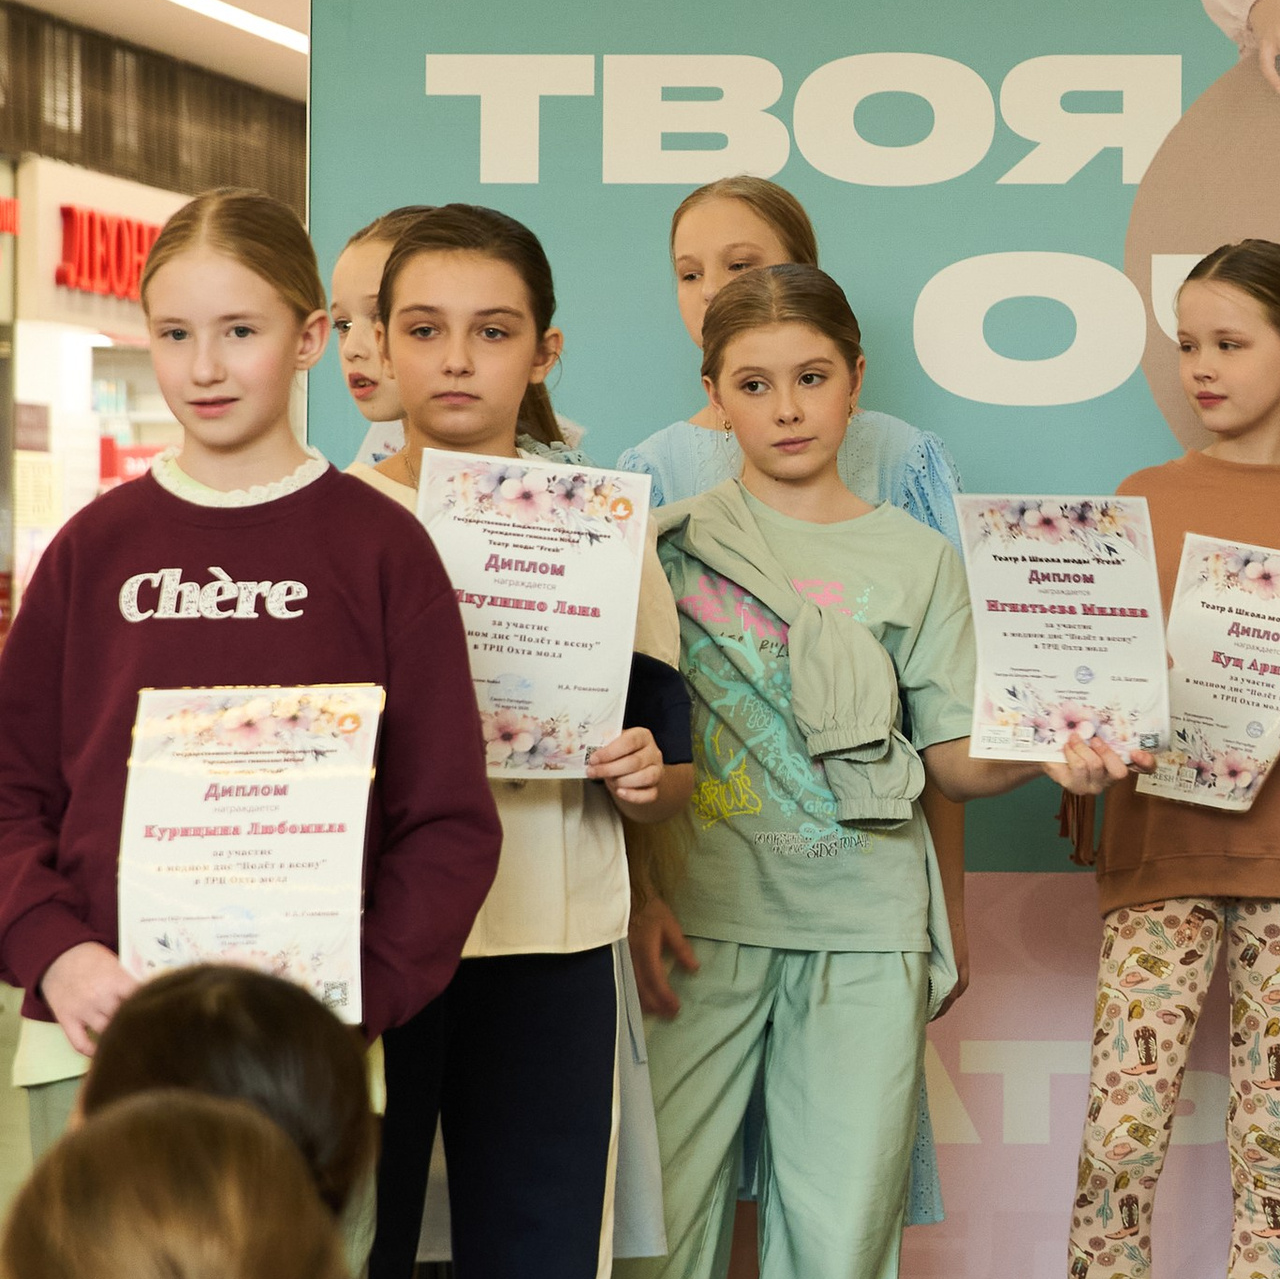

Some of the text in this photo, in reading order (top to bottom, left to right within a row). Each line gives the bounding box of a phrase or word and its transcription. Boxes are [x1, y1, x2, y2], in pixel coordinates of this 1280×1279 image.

[425, 52, 1182, 187] ТВОЯ
[55, 206, 162, 302] ЛЕОН
[484, 552, 565, 577] Диплом
[1028, 569, 1095, 585] Диплом
[118, 566, 309, 623] Chère
[552, 600, 601, 618] Лана
[203, 783, 289, 802] Диплом
